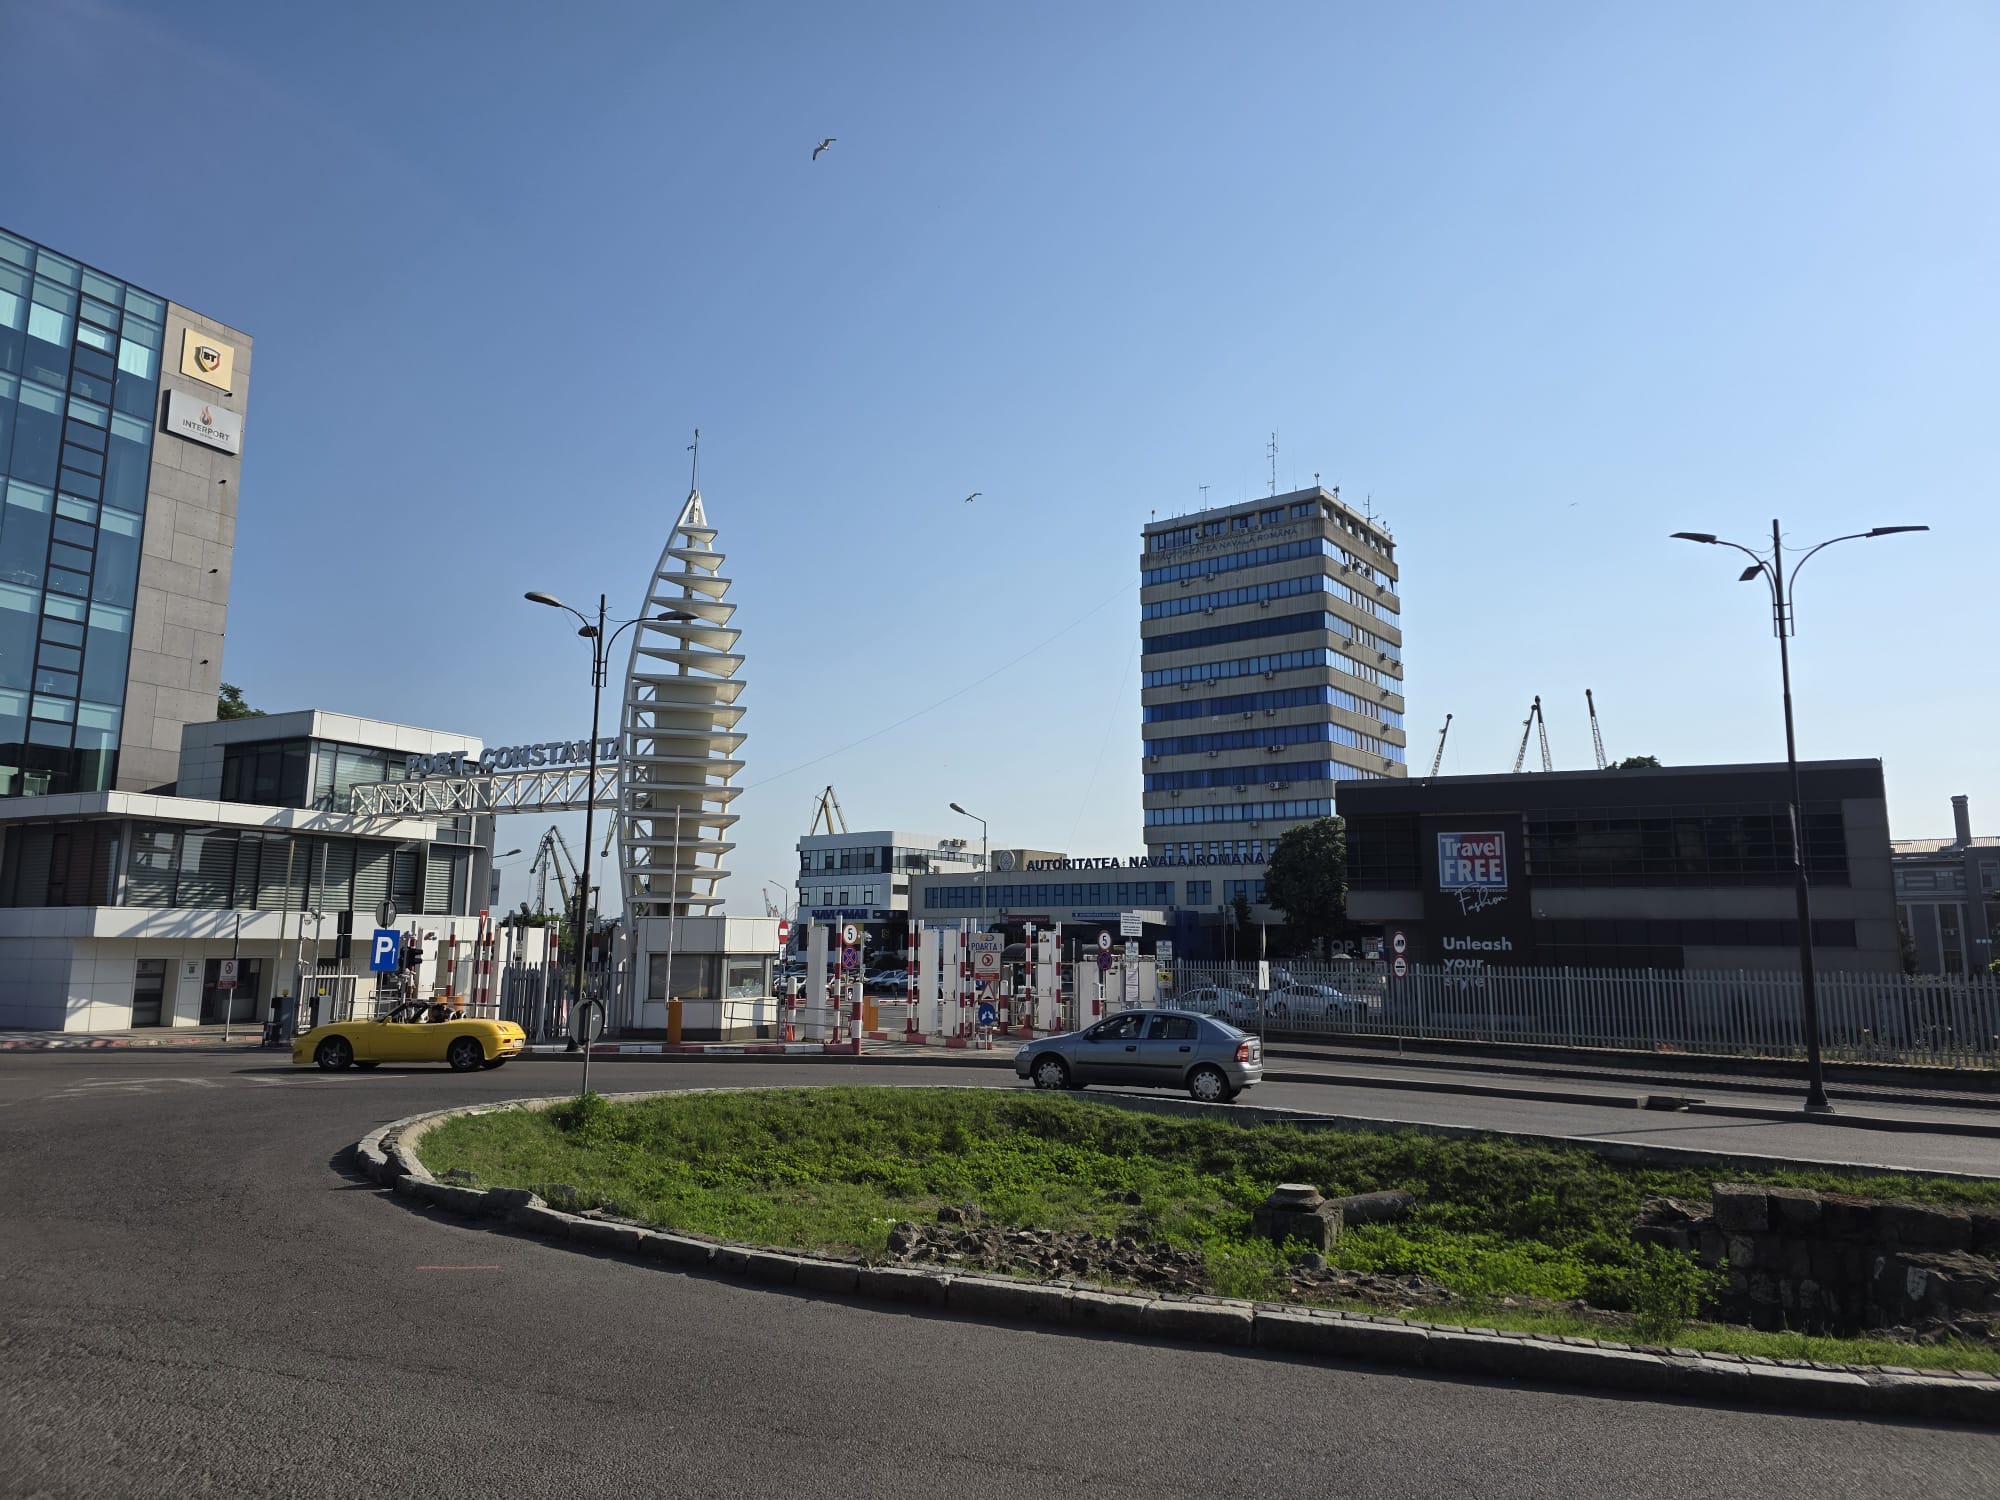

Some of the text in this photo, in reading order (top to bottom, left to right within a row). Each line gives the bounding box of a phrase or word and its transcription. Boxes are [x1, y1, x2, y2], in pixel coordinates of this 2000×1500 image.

[203, 351, 216, 362] BT
[182, 419, 230, 441] INTERPORT
[405, 751, 468, 776] PORT
[1441, 836, 1500, 856] Travel
[1026, 857, 1120, 871] AUTORITATEA
[1444, 859, 1502, 882] FREE
[1454, 882, 1507, 916] Fashion
[847, 927, 853, 941] 5
[1102, 935, 1108, 947] 5
[374, 936, 393, 964] P
[971, 942, 998, 951] POARTA
[1443, 936, 1513, 951] Unleash
[1443, 959, 1484, 976] your
